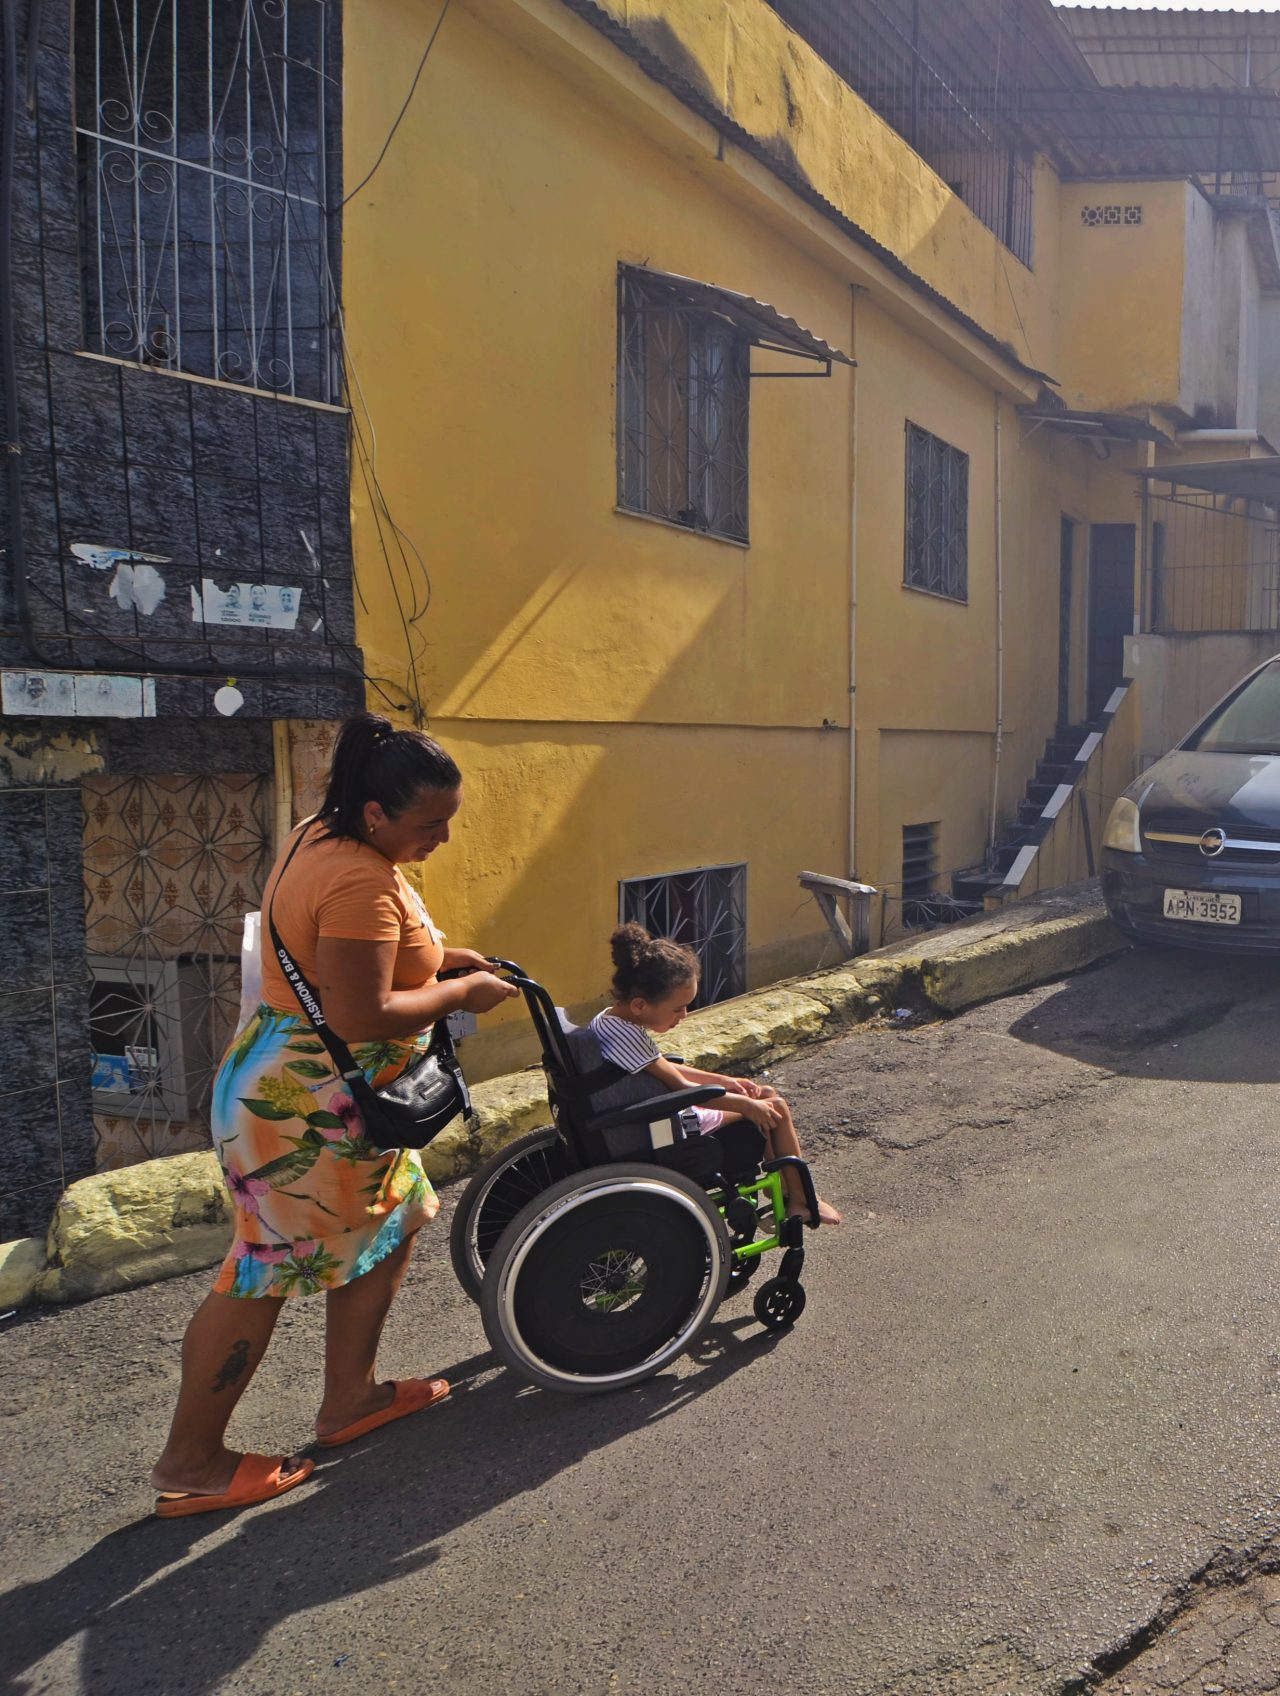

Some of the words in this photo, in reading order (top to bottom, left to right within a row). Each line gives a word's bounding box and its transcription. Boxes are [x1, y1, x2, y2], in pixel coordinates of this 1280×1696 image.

[278, 949, 294, 972] BAG
[289, 971, 300, 981] &
[295, 981, 326, 1026] FASHION
